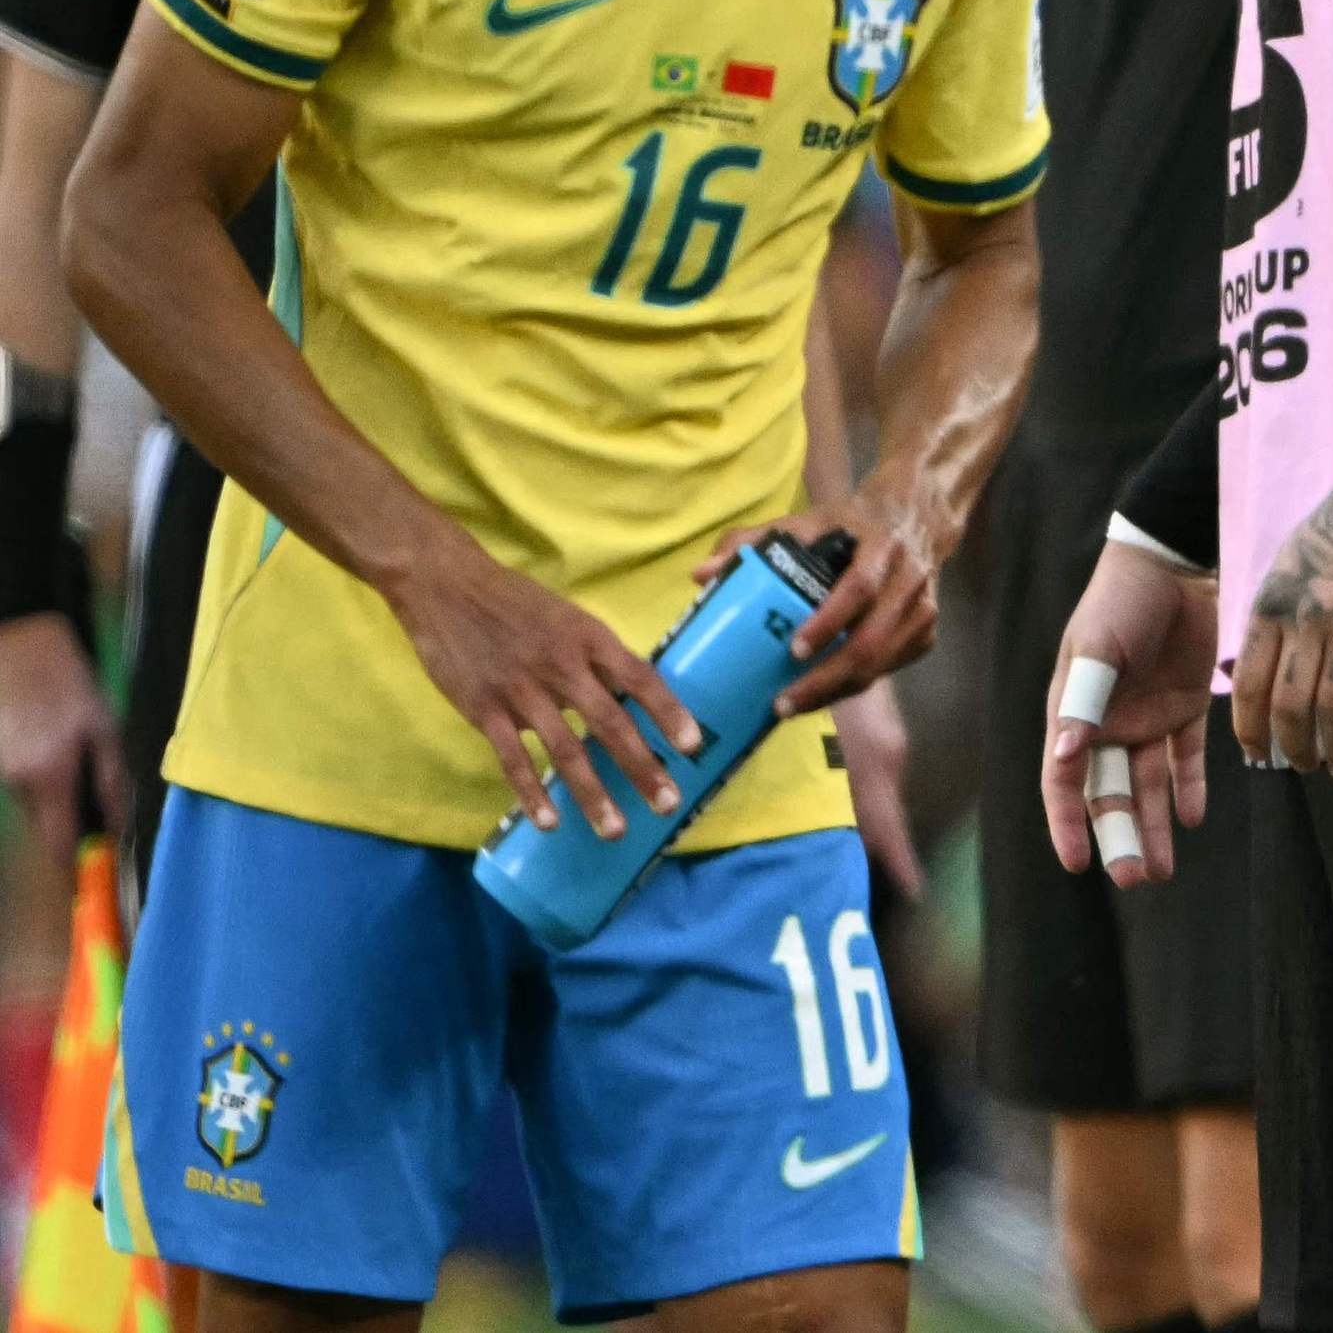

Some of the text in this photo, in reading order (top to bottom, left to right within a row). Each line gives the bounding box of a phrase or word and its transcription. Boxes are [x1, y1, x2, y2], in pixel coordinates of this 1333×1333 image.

[591, 130, 763, 309] 16
[769, 908, 891, 1099] 16
[219, 1092, 248, 1109] CBF
[184, 1166, 267, 1207] BRASIL
